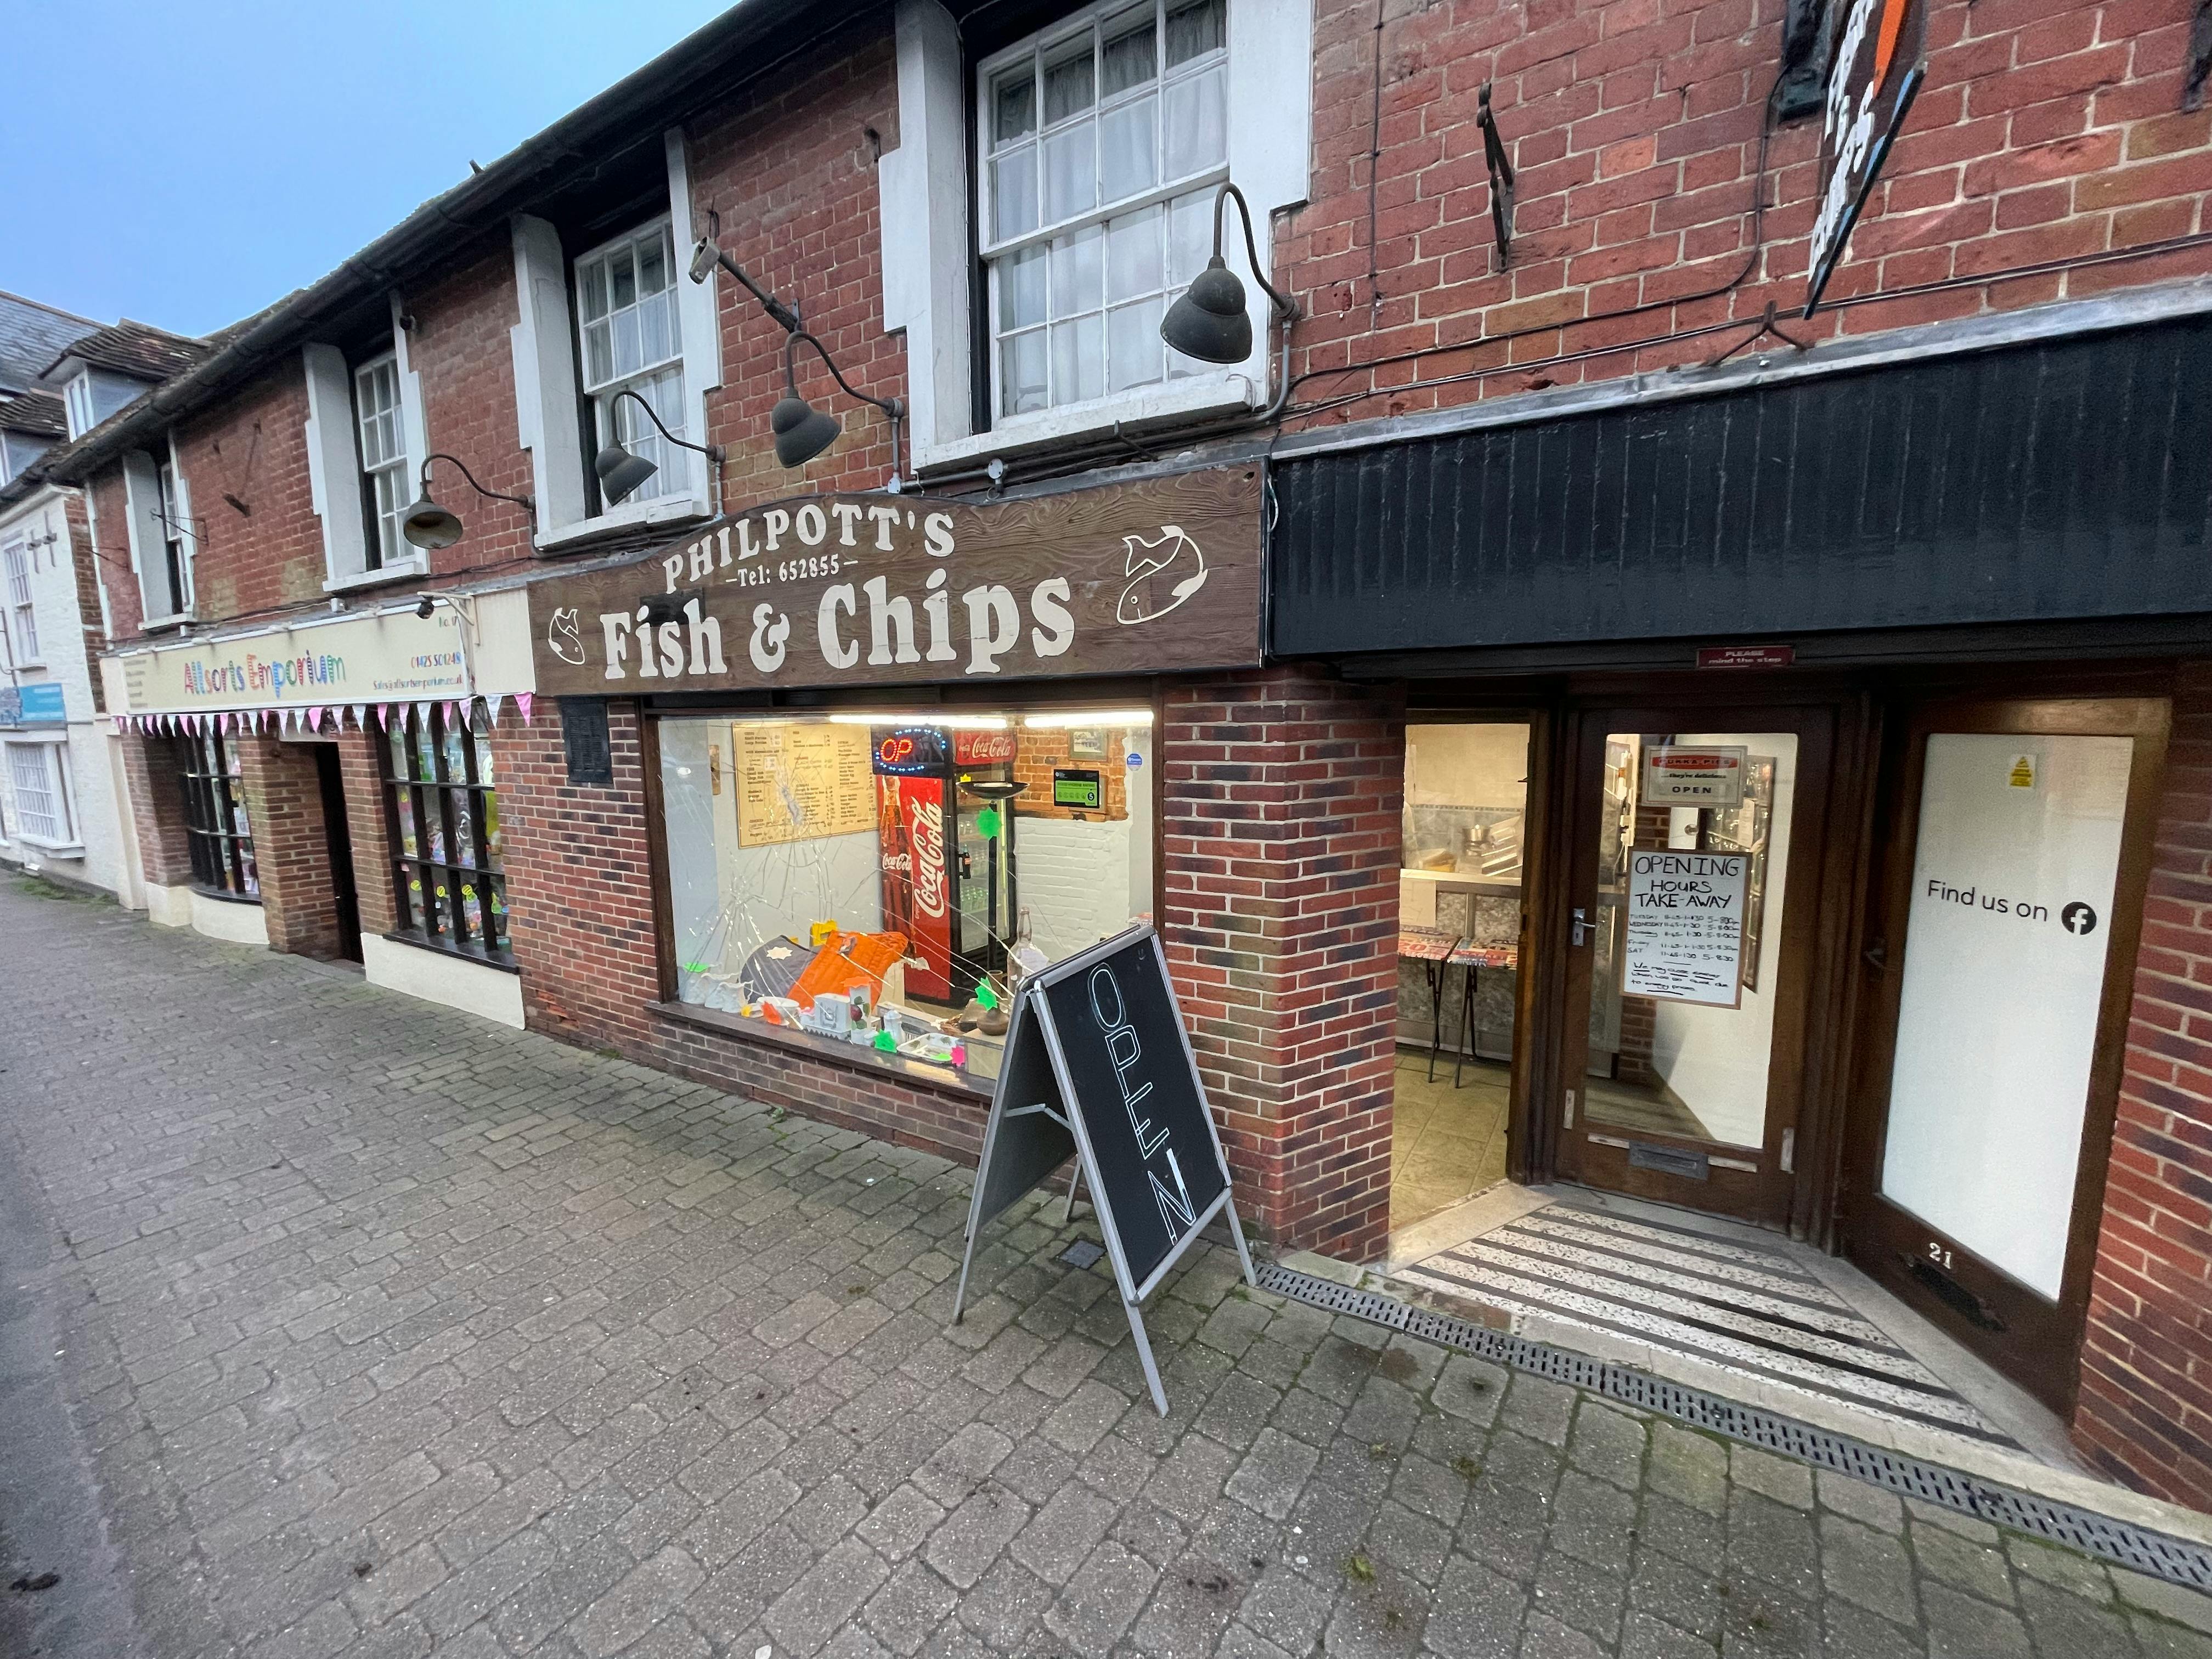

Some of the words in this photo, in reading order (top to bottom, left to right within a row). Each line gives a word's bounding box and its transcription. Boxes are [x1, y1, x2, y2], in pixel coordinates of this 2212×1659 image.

[663, 503, 955, 594] PHILPOTT'S
[600, 598, 727, 679] Fish
[749, 603, 790, 673] &
[817, 568, 1076, 675] Chips
[184, 661, 246, 695] Allsorts
[246, 650, 346, 699] Emporium
[1635, 855, 1741, 877] OPENING
[1651, 879, 1712, 893] HOURS
[1928, 879, 1976, 905] Find
[1982, 895, 2008, 913] us
[2016, 902, 2048, 922] on
[1088, 963, 1197, 1245] OPEN
[1929, 1243, 1951, 1269] 21
